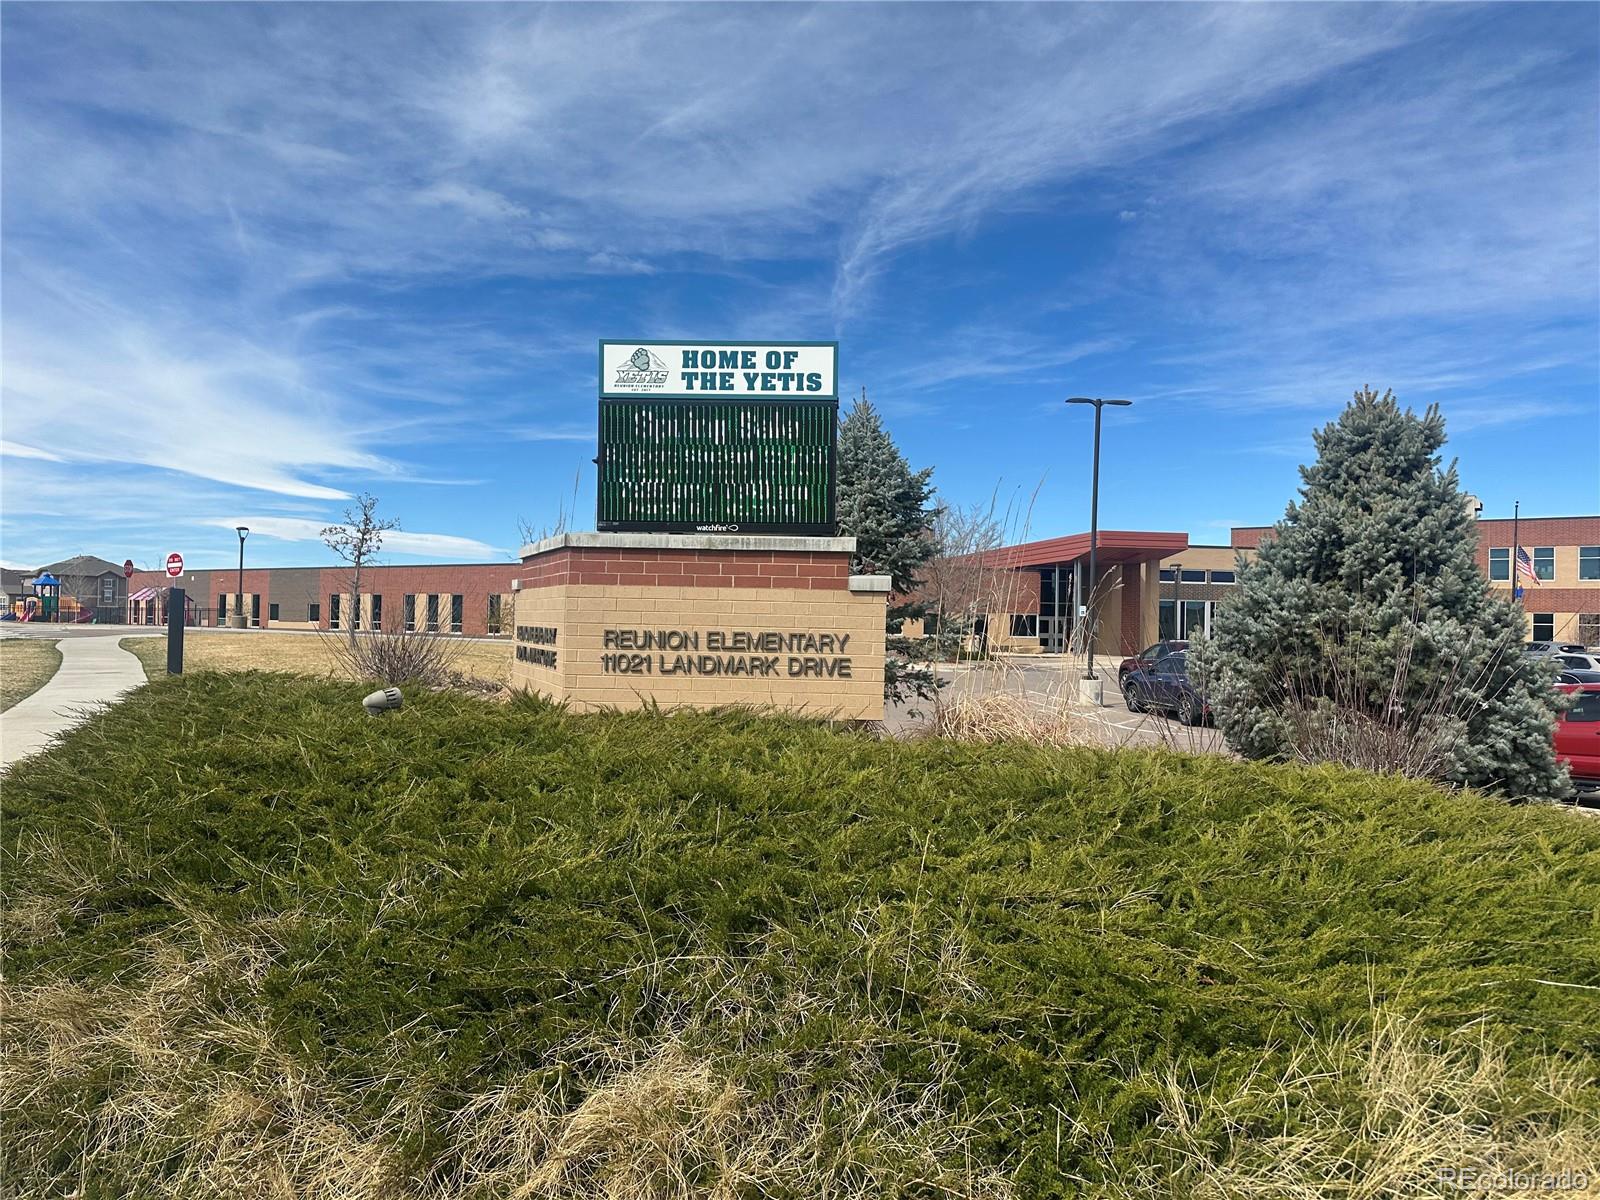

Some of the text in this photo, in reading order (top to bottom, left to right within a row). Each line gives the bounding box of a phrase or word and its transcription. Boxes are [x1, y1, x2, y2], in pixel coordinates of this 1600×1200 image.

[682, 350, 799, 370] HOME OF
[615, 370, 669, 383] YETIS
[681, 371, 822, 392] THE YETIS
[603, 629, 850, 654] REUNION ELEMENTARY
[601, 653, 851, 677] 11021 LANDMARK DRIVE
